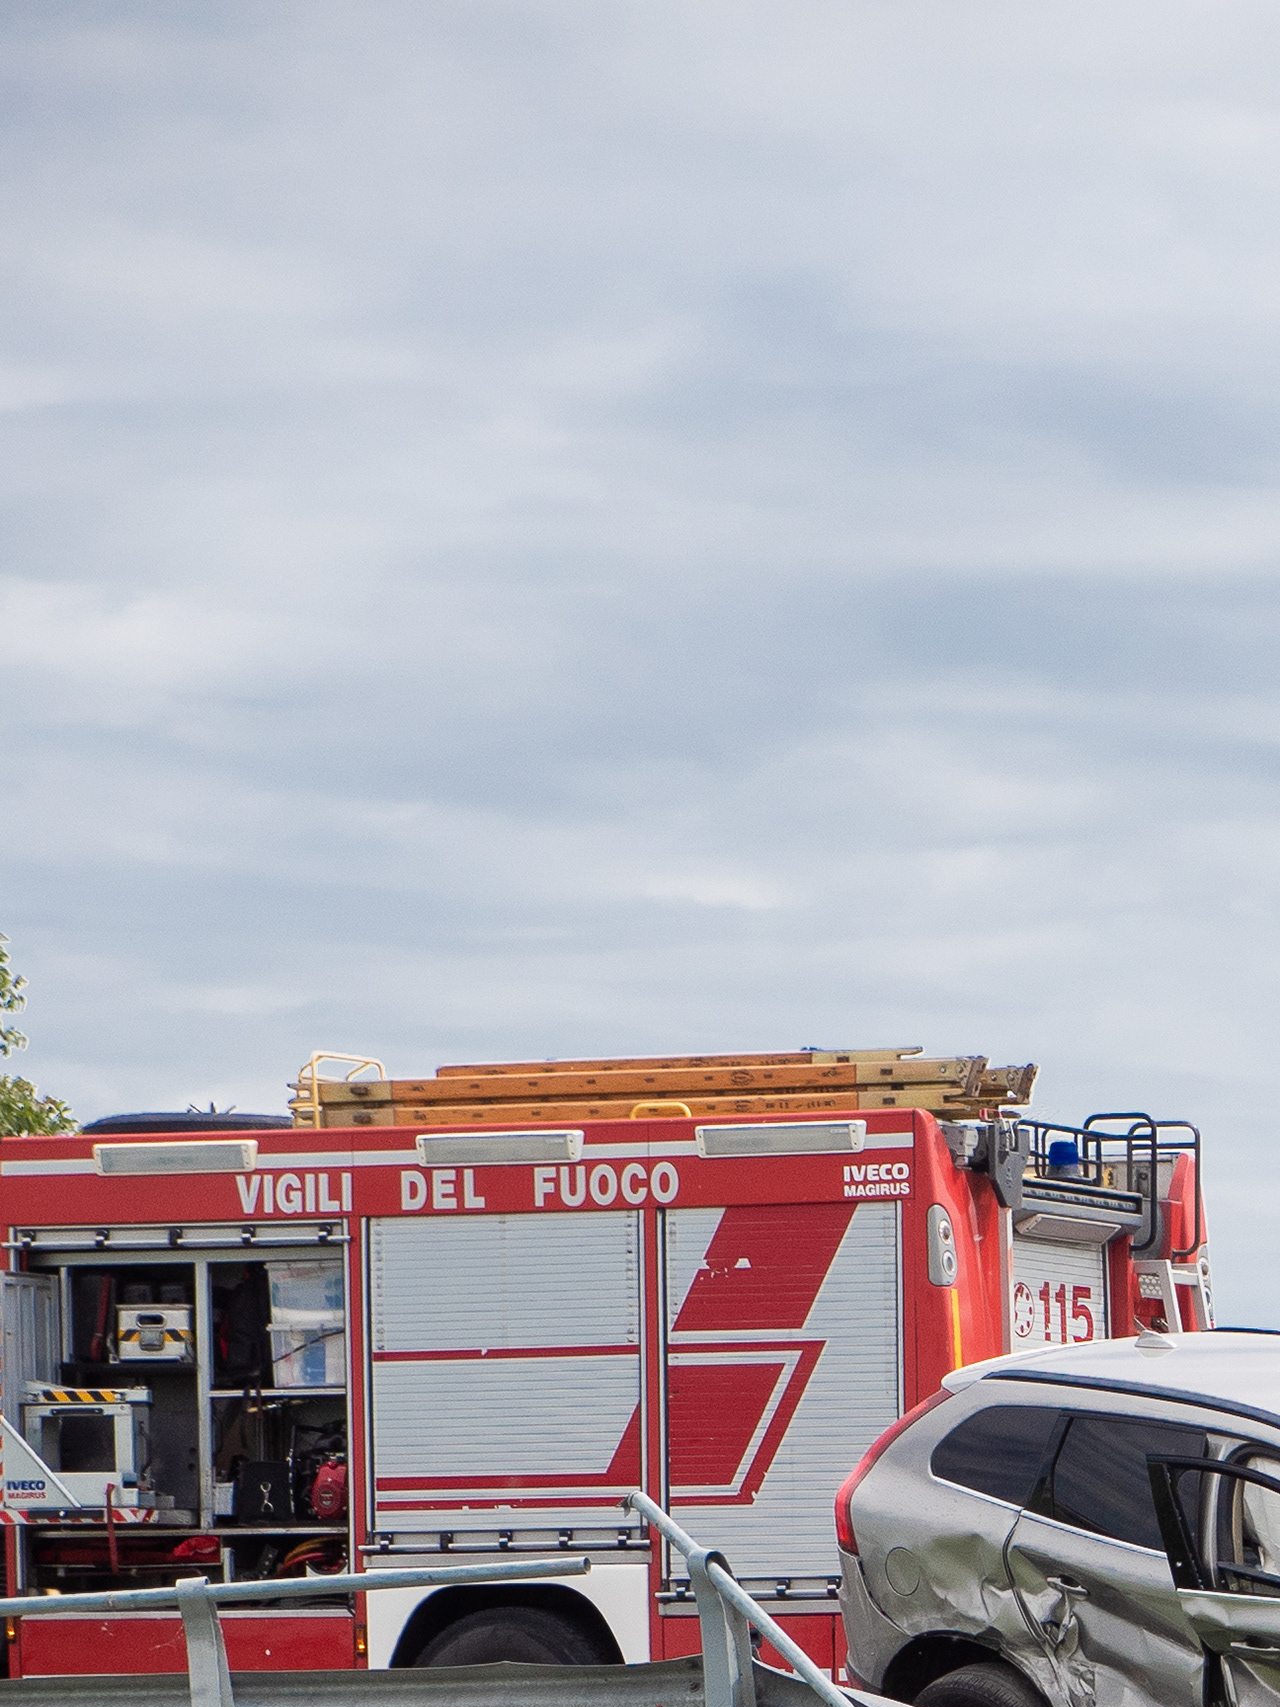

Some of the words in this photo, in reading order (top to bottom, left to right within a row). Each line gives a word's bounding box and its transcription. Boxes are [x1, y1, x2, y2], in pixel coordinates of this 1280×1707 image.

[843, 1163, 910, 1182] IVECO
[235, 1173, 353, 1214] VIGILI
[400, 1168, 485, 1211] DEL
[533, 1161, 680, 1208] FUOCO
[844, 1182, 910, 1197] MAGIRUS
[1039, 1281, 1094, 1345] 115
[6, 1480, 46, 1490] IVECO
